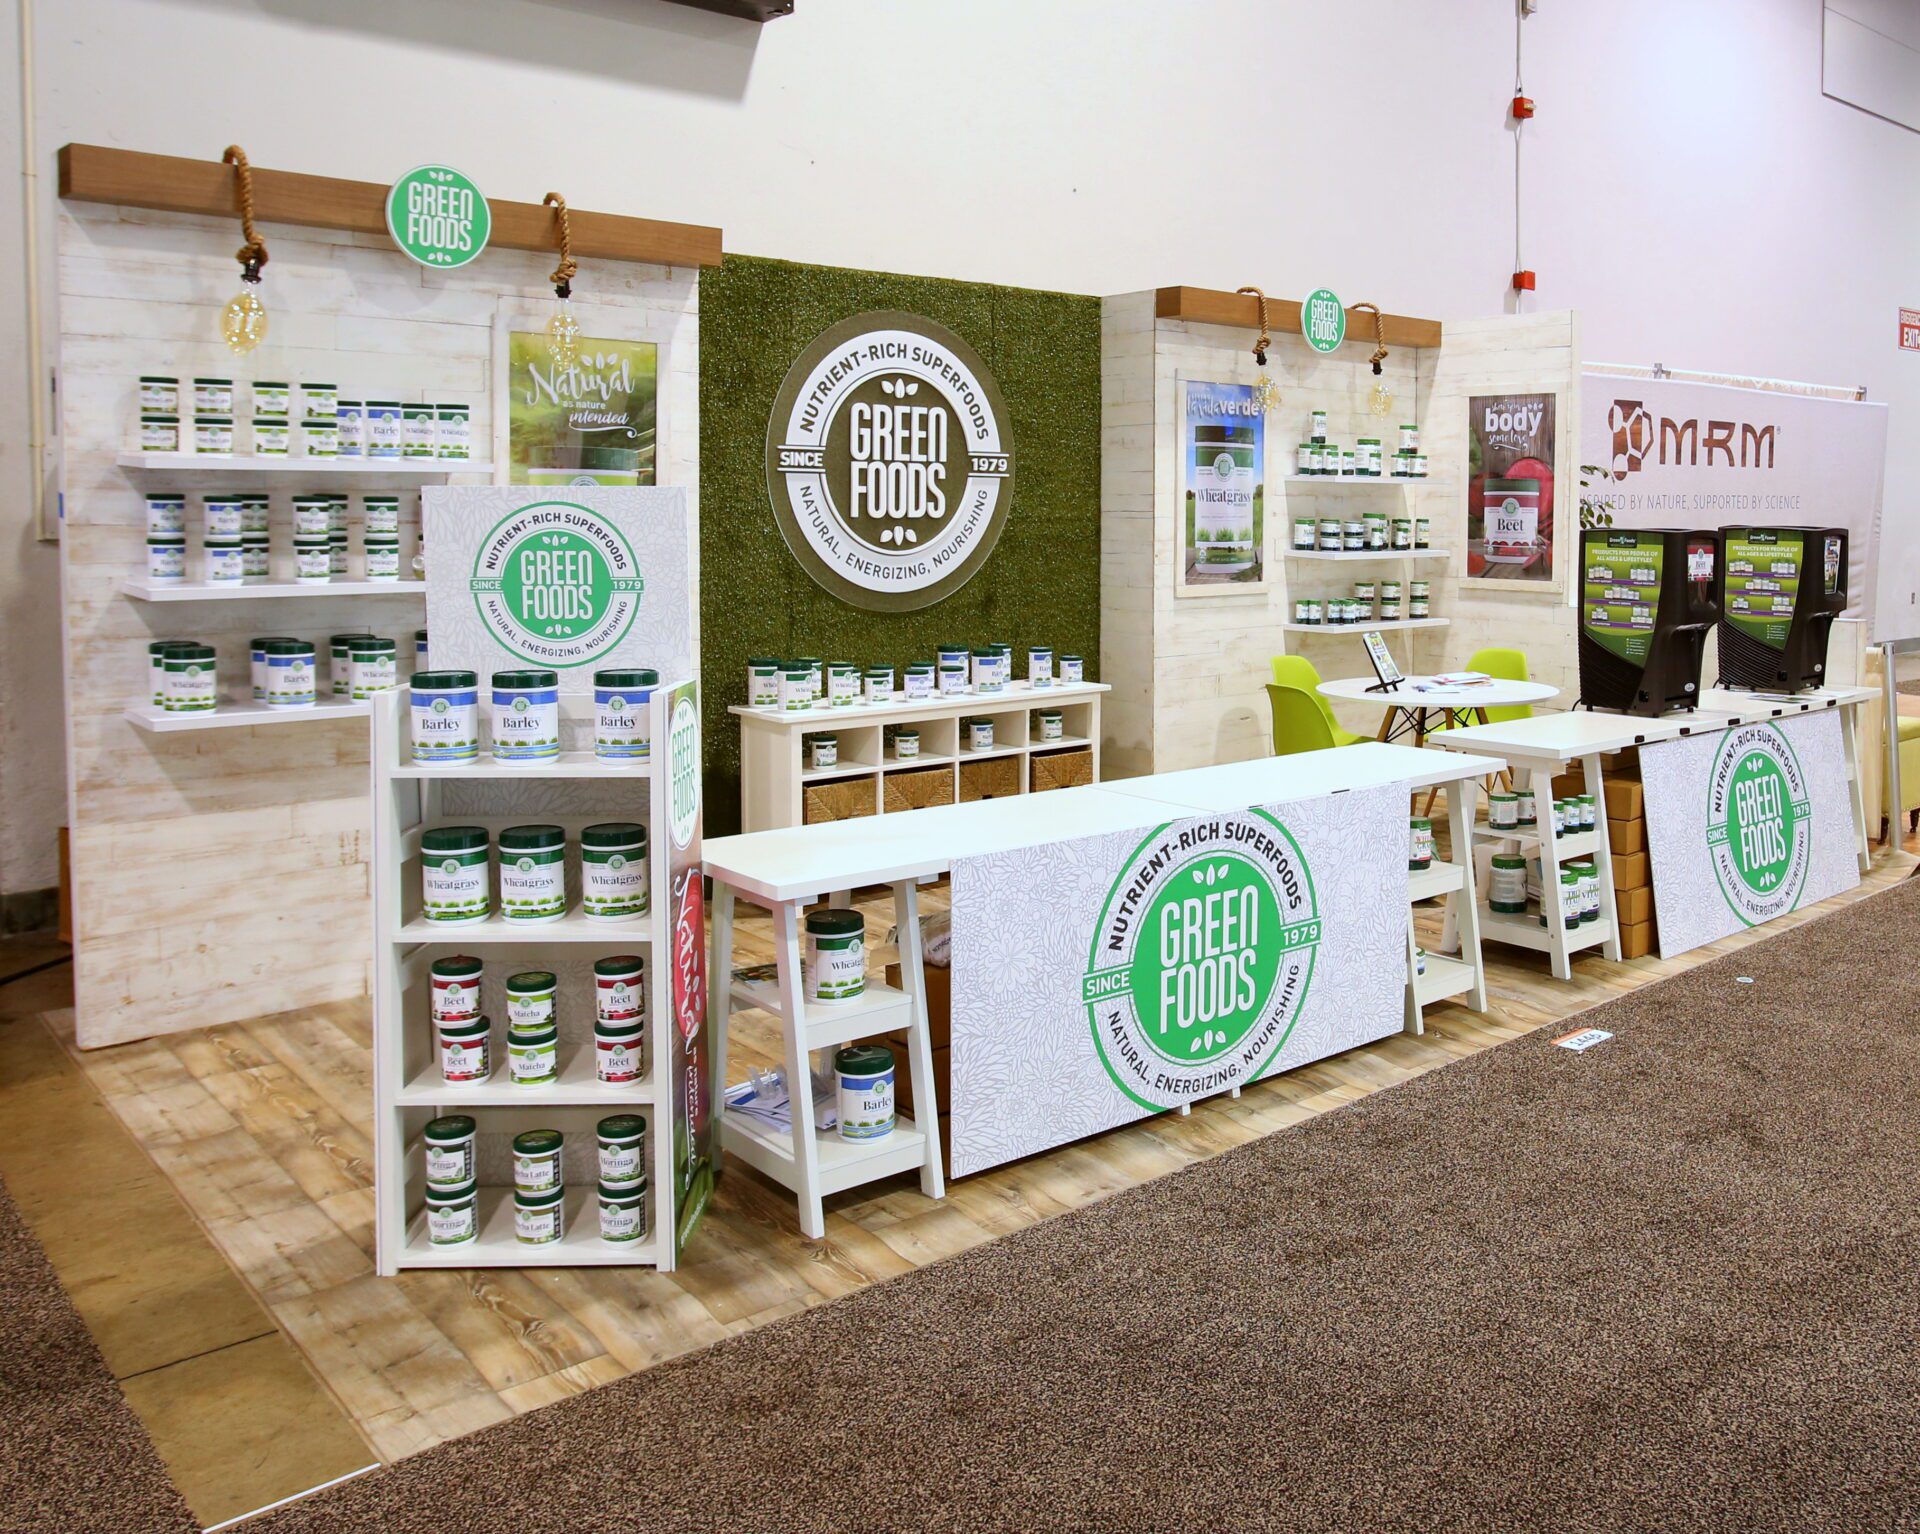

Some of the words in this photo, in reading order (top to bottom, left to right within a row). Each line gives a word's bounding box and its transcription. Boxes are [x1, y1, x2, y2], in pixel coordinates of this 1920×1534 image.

[408, 181, 473, 220] GREEN
[408, 213, 472, 251] FOODS
[1311, 299, 1338, 322] GREEN
[1311, 319, 1338, 342] FOODS
[527, 358, 635, 405] Natural
[800, 343, 907, 433] NUTRIENT-RICH
[912, 346, 988, 440] SUPERFOODS
[563, 401, 574, 409] as
[576, 401, 606, 409] nature
[570, 410, 629, 424] intended
[1219, 398, 1259, 416] verde
[1485, 406, 1542, 437] body
[850, 402, 947, 462] GREEN
[780, 452, 823, 467] SINCE
[972, 457, 1007, 471] 1979
[850, 461, 947, 519] FOODS
[1198, 488, 1251, 504] Wheatgrass
[1630, 494, 1643, 509] BY
[1647, 494, 1690, 511] NATURE,
[1694, 494, 1749, 510] SUPPORTED
[1751, 494, 1764, 509] BY
[1765, 494, 1800, 510] SCIENCE
[486, 513, 561, 570] NUTRIENT-RICH
[565, 514, 627, 570] SUPERFOODS
[801, 486, 840, 559] NATURAL,
[845, 552, 931, 579] ENERGIZING,
[933, 490, 988, 567] NOURISHING
[1497, 518, 1523, 532] Beet
[520, 550, 593, 585] GREEN
[472, 581, 501, 590] SINCE
[521, 585, 593, 620] FOODS
[613, 581, 641, 590] 1979
[488, 600, 518, 643] NATURAL,
[521, 639, 585, 657] ENERGIZING,
[586, 601, 627, 649] NOURISHING
[422, 718, 462, 731] Barley
[502, 717, 541, 730] Barley
[601, 716, 637, 729] Barley
[672, 724, 695, 776] GREEN
[1715, 730, 1756, 812] NUTRIENT-RICH
[1757, 730, 1799, 793] SUPERFOODS
[673, 769, 696, 826] FOODS
[1735, 773, 1782, 827] GREEN
[1793, 804, 1810, 817] 1979
[1707, 827, 1728, 843] SINCE
[1740, 818, 1786, 872] FOODS
[426, 878, 480, 890] Wheatgrass
[591, 873, 643, 886] Wheatgrass
[1786, 831, 1804, 899] NOURISHING
[1108, 822, 1219, 951] NUTRIENT-RICH
[1224, 822, 1301, 910] SUPERFOODS
[1160, 885, 1258, 969] GREEN
[1284, 925, 1317, 946] 1979
[674, 868, 700, 1054] Natural
[1086, 971, 1129, 996] SINCE
[1159, 948, 1256, 1034] FOODS
[443, 996, 466, 1006] Beet
[513, 1009, 541, 1018] Matcha
[610, 995, 632, 1004] Beet
[1108, 1011, 1150, 1086] NATURAL,
[1154, 1063, 1242, 1094] ENERGIZING,
[1244, 964, 1299, 1065] NOURISHING
[447, 1056, 467, 1066] Beet
[518, 1061, 546, 1071] Matcha
[608, 1057, 630, 1067] Beet
